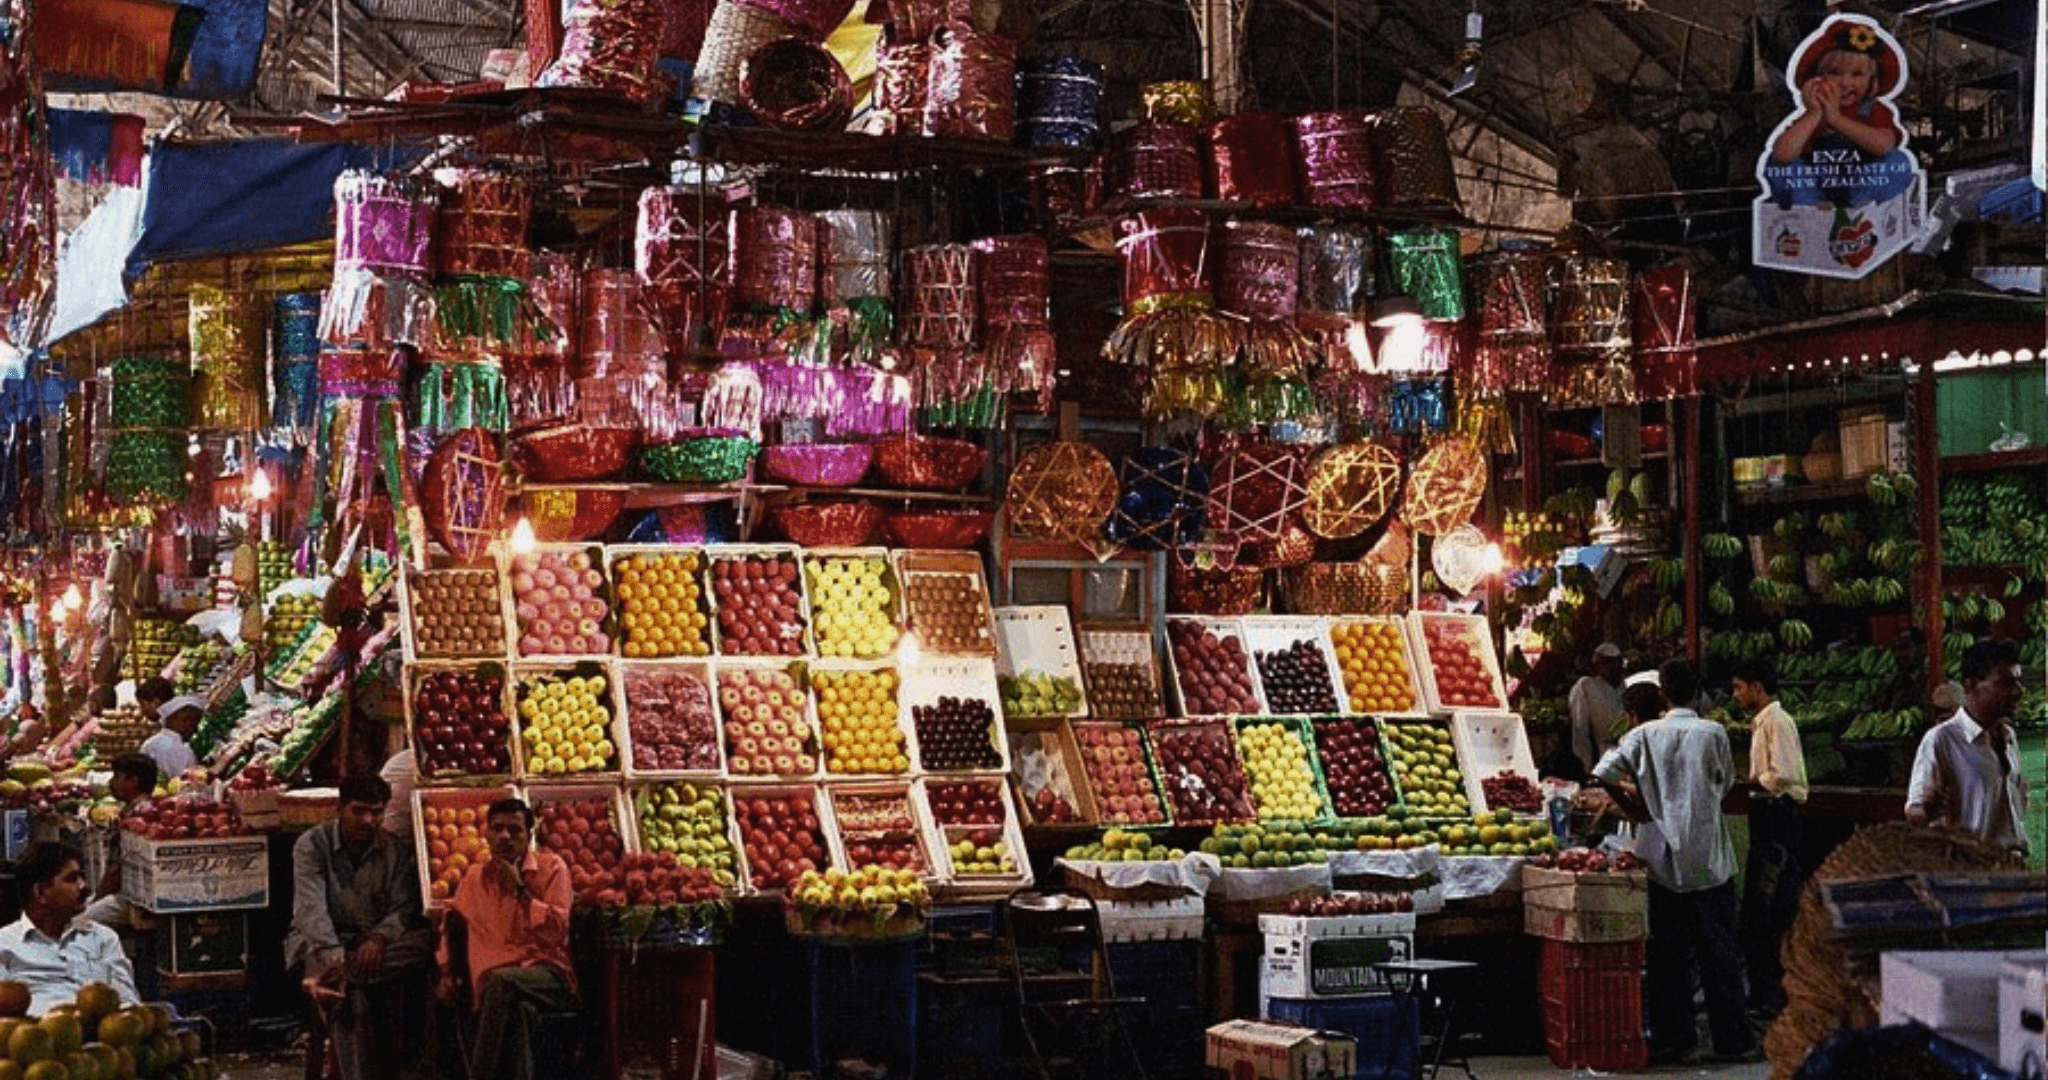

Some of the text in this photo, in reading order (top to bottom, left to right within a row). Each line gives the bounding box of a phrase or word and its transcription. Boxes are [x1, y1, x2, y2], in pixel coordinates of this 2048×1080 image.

[1813, 149, 1860, 163] ENZA
[1766, 162, 1906, 177] THE FRESH TASTE OF
[1786, 176, 1889, 188] NEW ZEALAND
[1314, 966, 1378, 986] MOUNTAIN
